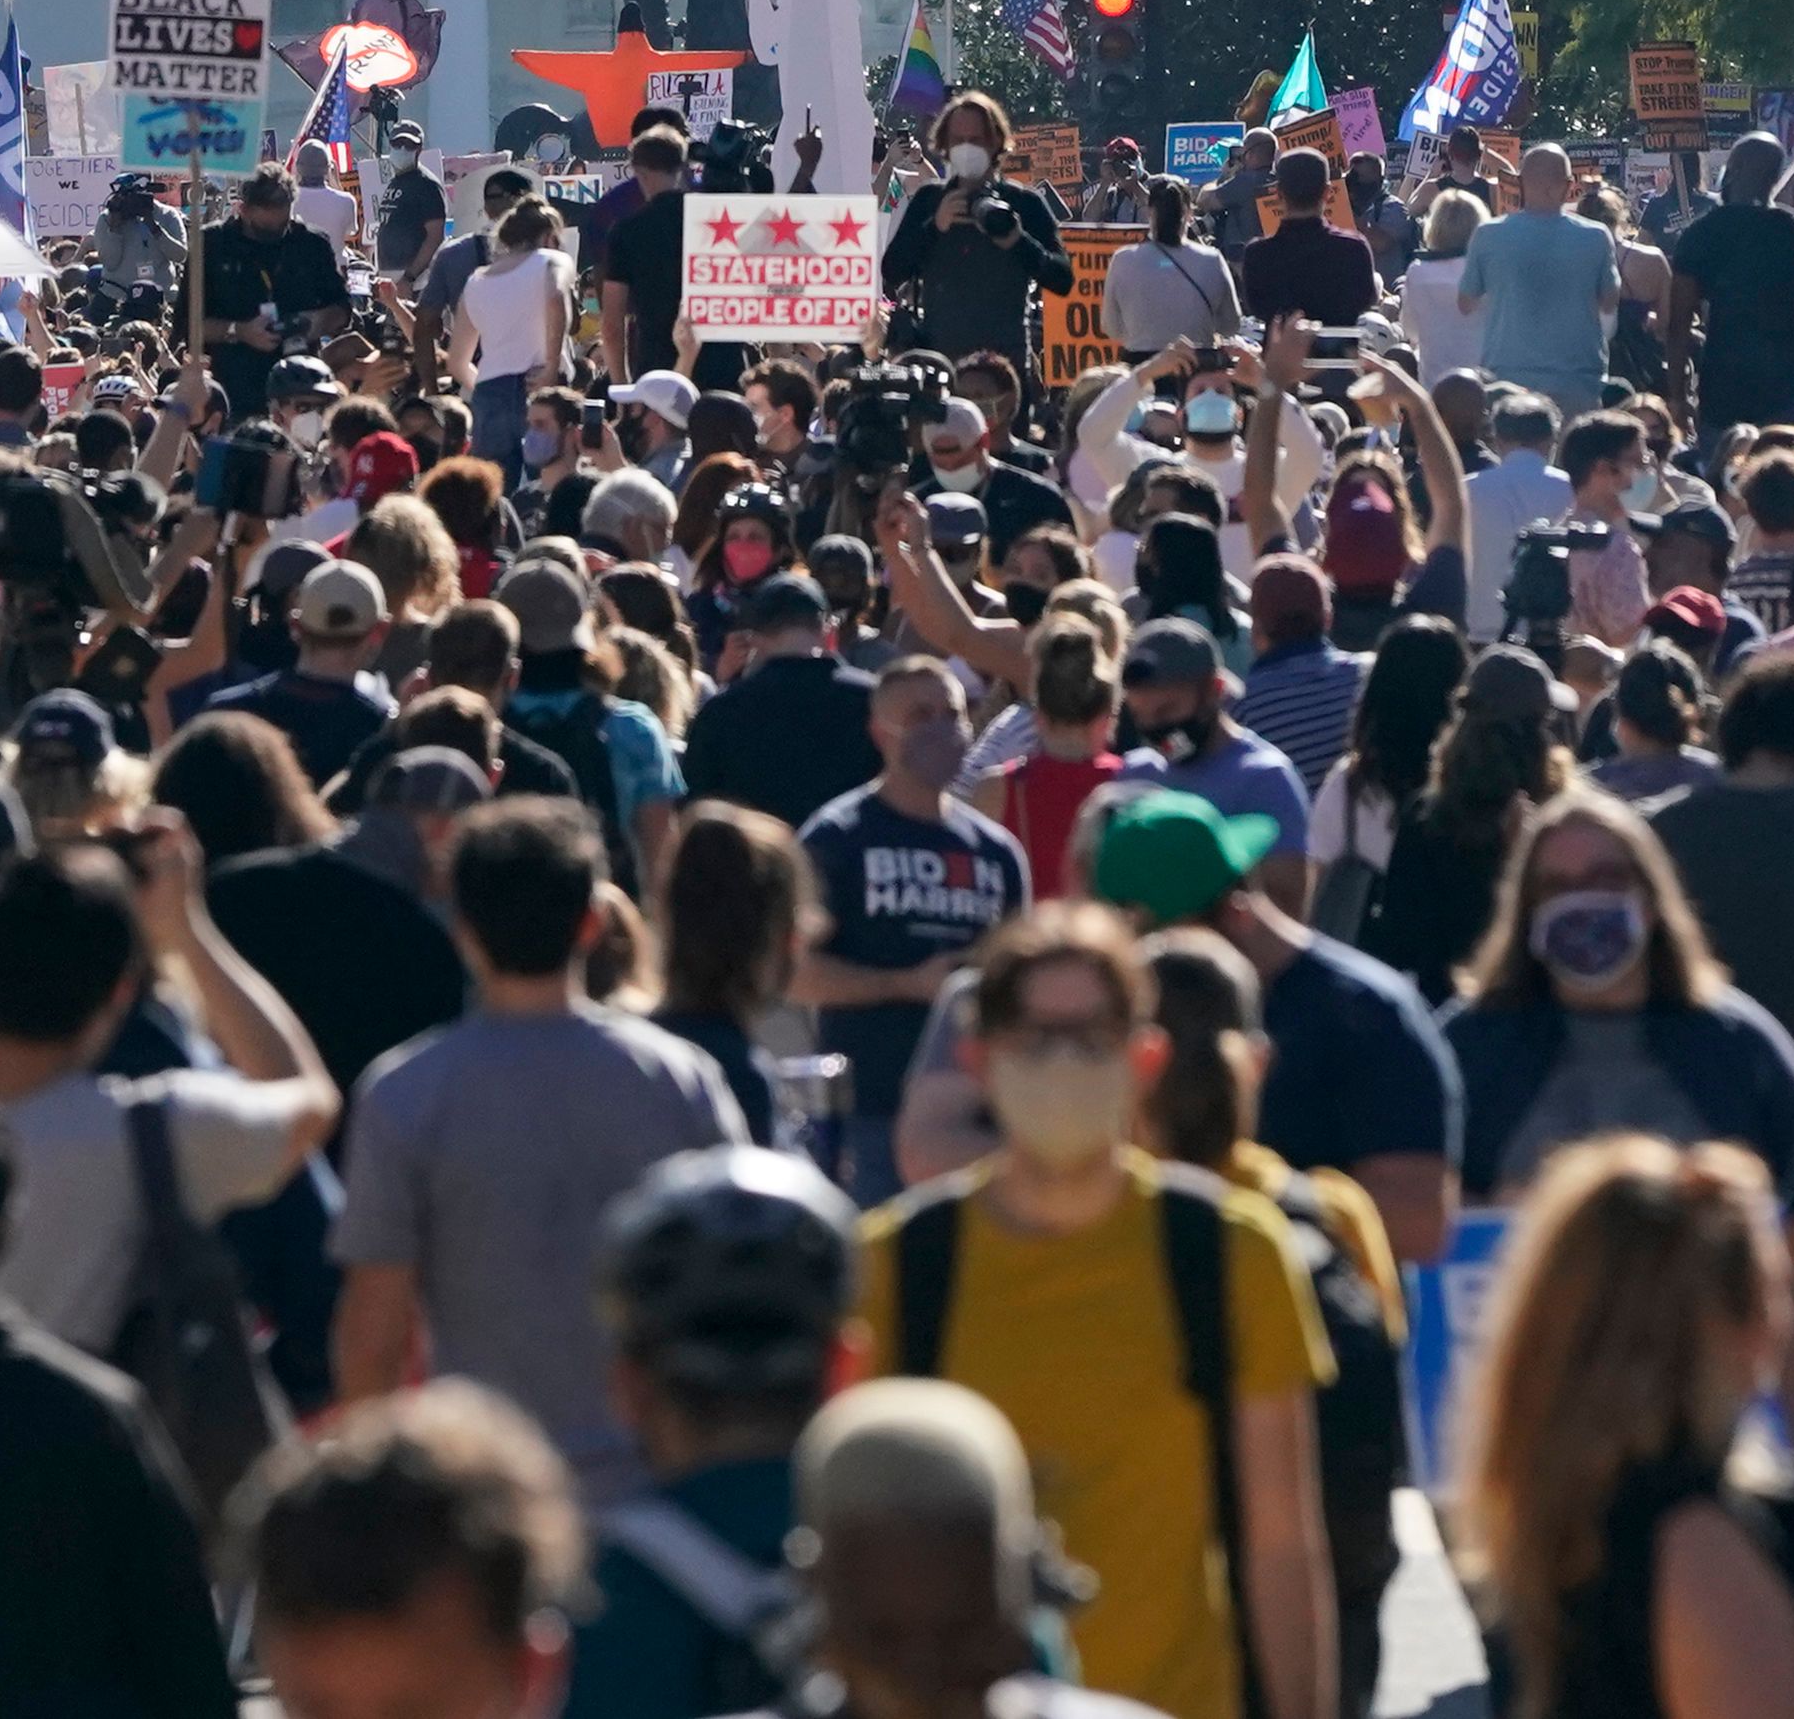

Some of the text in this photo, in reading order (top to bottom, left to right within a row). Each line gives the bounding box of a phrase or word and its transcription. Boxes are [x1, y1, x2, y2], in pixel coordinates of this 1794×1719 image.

[117, 17, 233, 54] LIVES
[115, 61, 257, 93] MATTER
[58, 180, 80, 190] WE
[692, 256, 871, 285] STATEHOOD
[690, 297, 869, 325] PEOPLE OF DC
